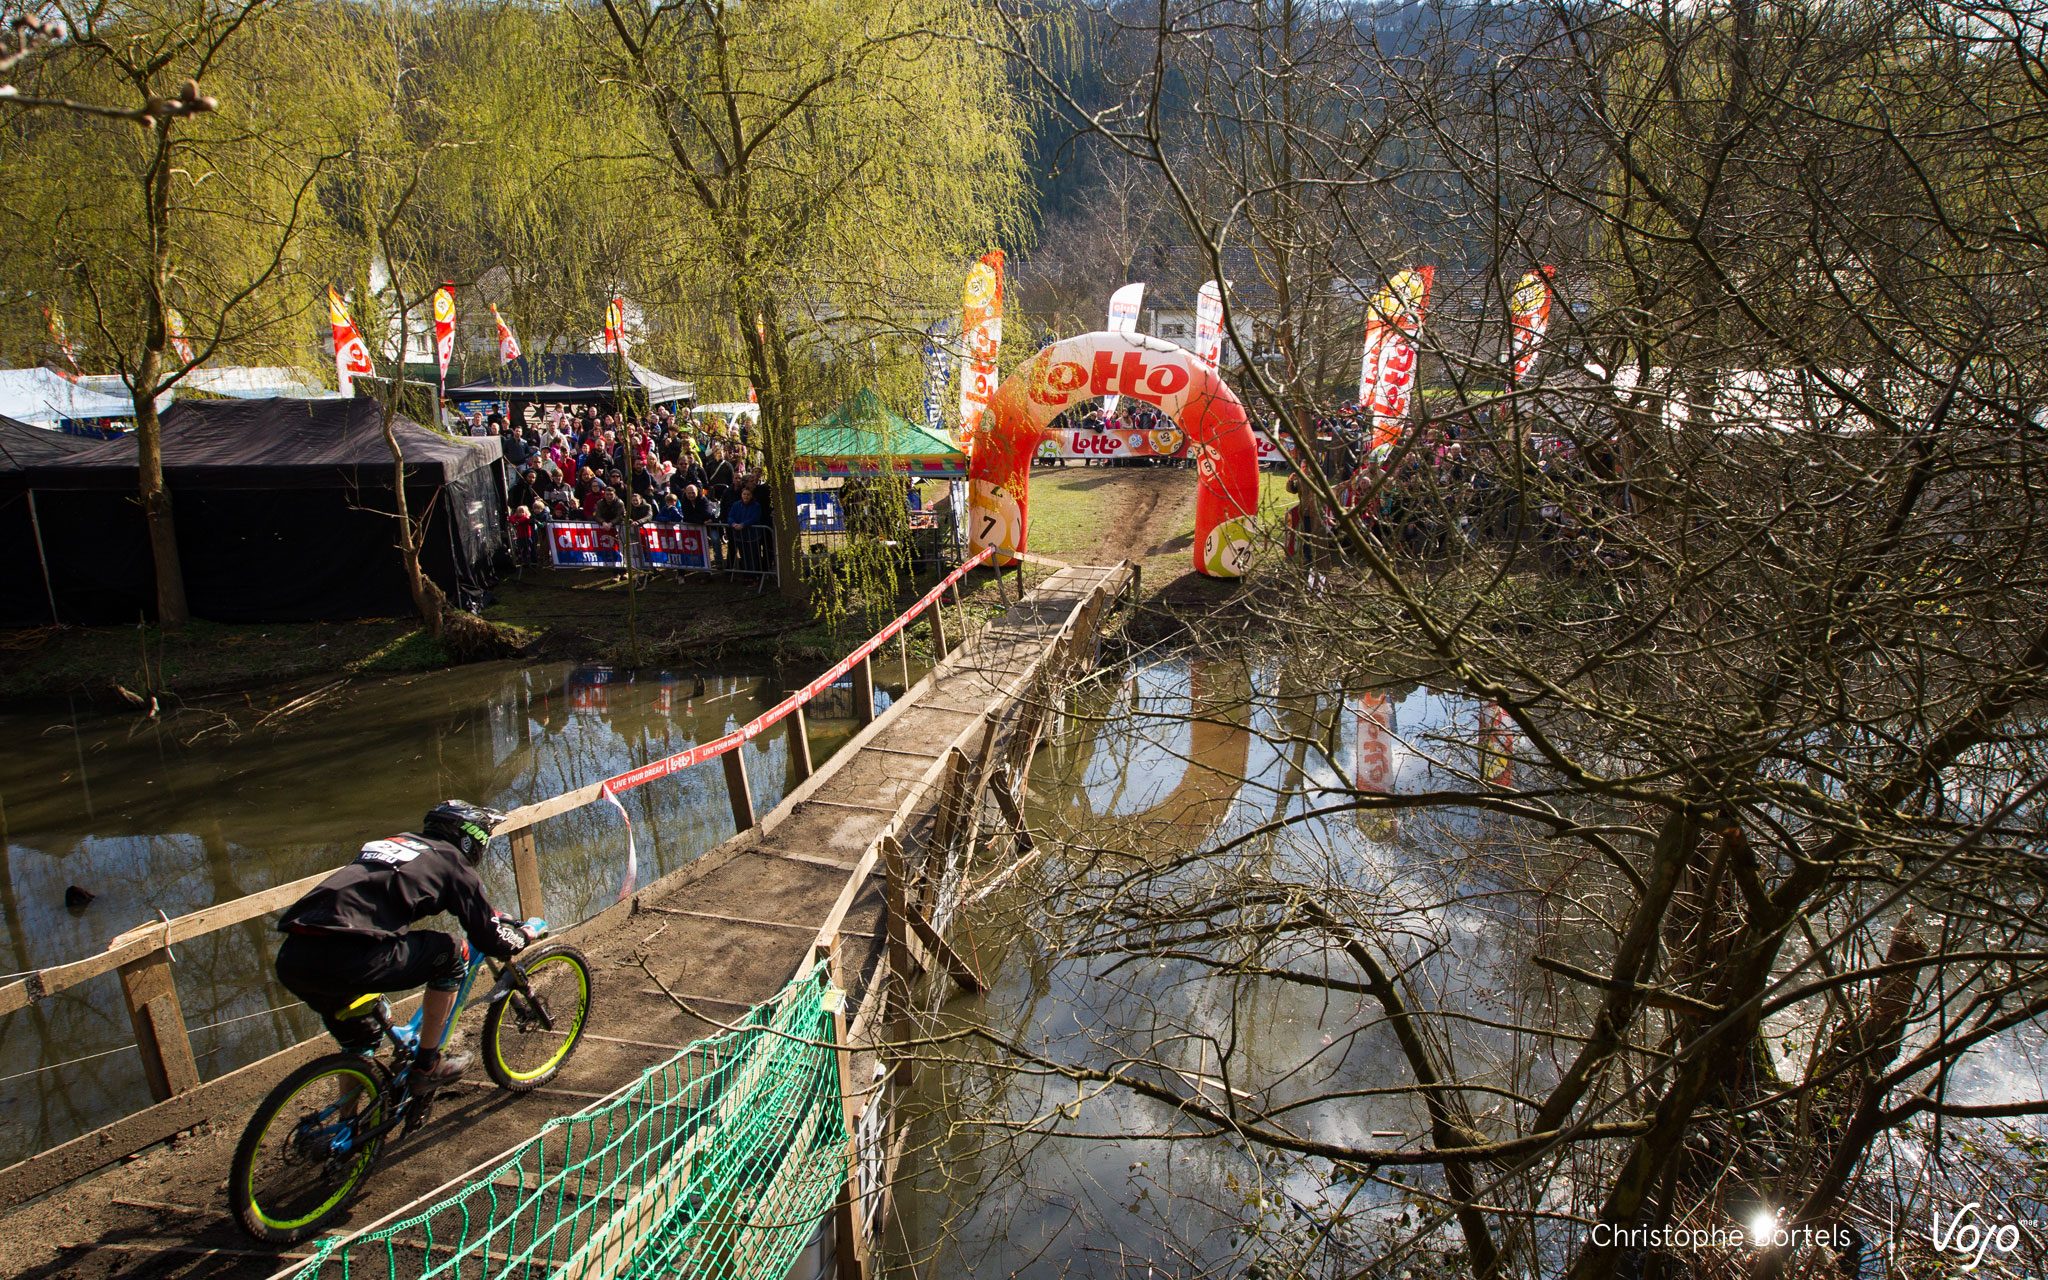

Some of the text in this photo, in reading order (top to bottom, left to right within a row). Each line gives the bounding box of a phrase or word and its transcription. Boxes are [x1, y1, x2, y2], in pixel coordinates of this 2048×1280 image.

[980, 516, 997, 540] 7
[612, 779, 627, 789] LIVE
[627, 772, 644, 784] YOUR
[460, 821, 489, 846] 100%
[361, 851, 398, 864] ISUZU
